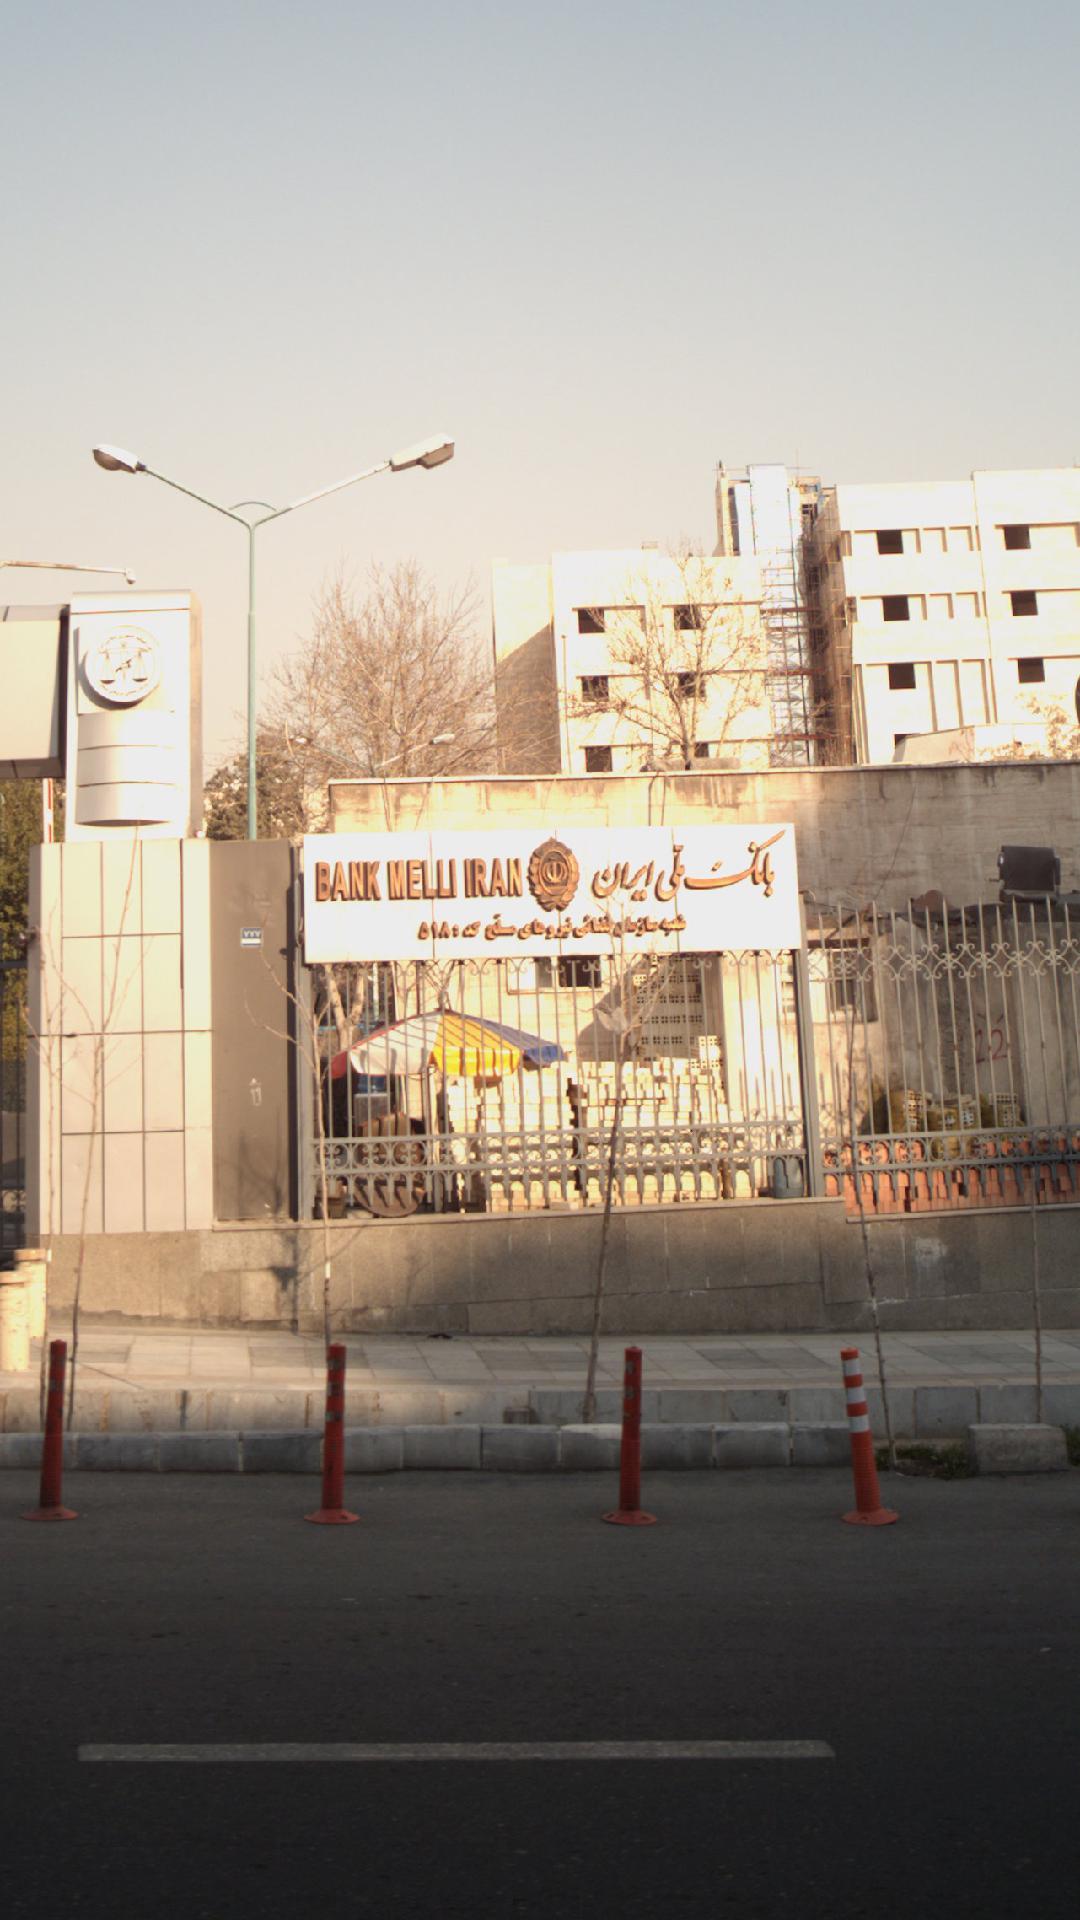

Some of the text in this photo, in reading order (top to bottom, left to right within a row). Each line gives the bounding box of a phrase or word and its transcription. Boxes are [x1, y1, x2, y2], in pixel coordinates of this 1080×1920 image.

[315, 857, 523, 901] BANK MELLI IRAN
[591, 860, 655, 902] ایران
[684, 829, 787, 898] بانک
